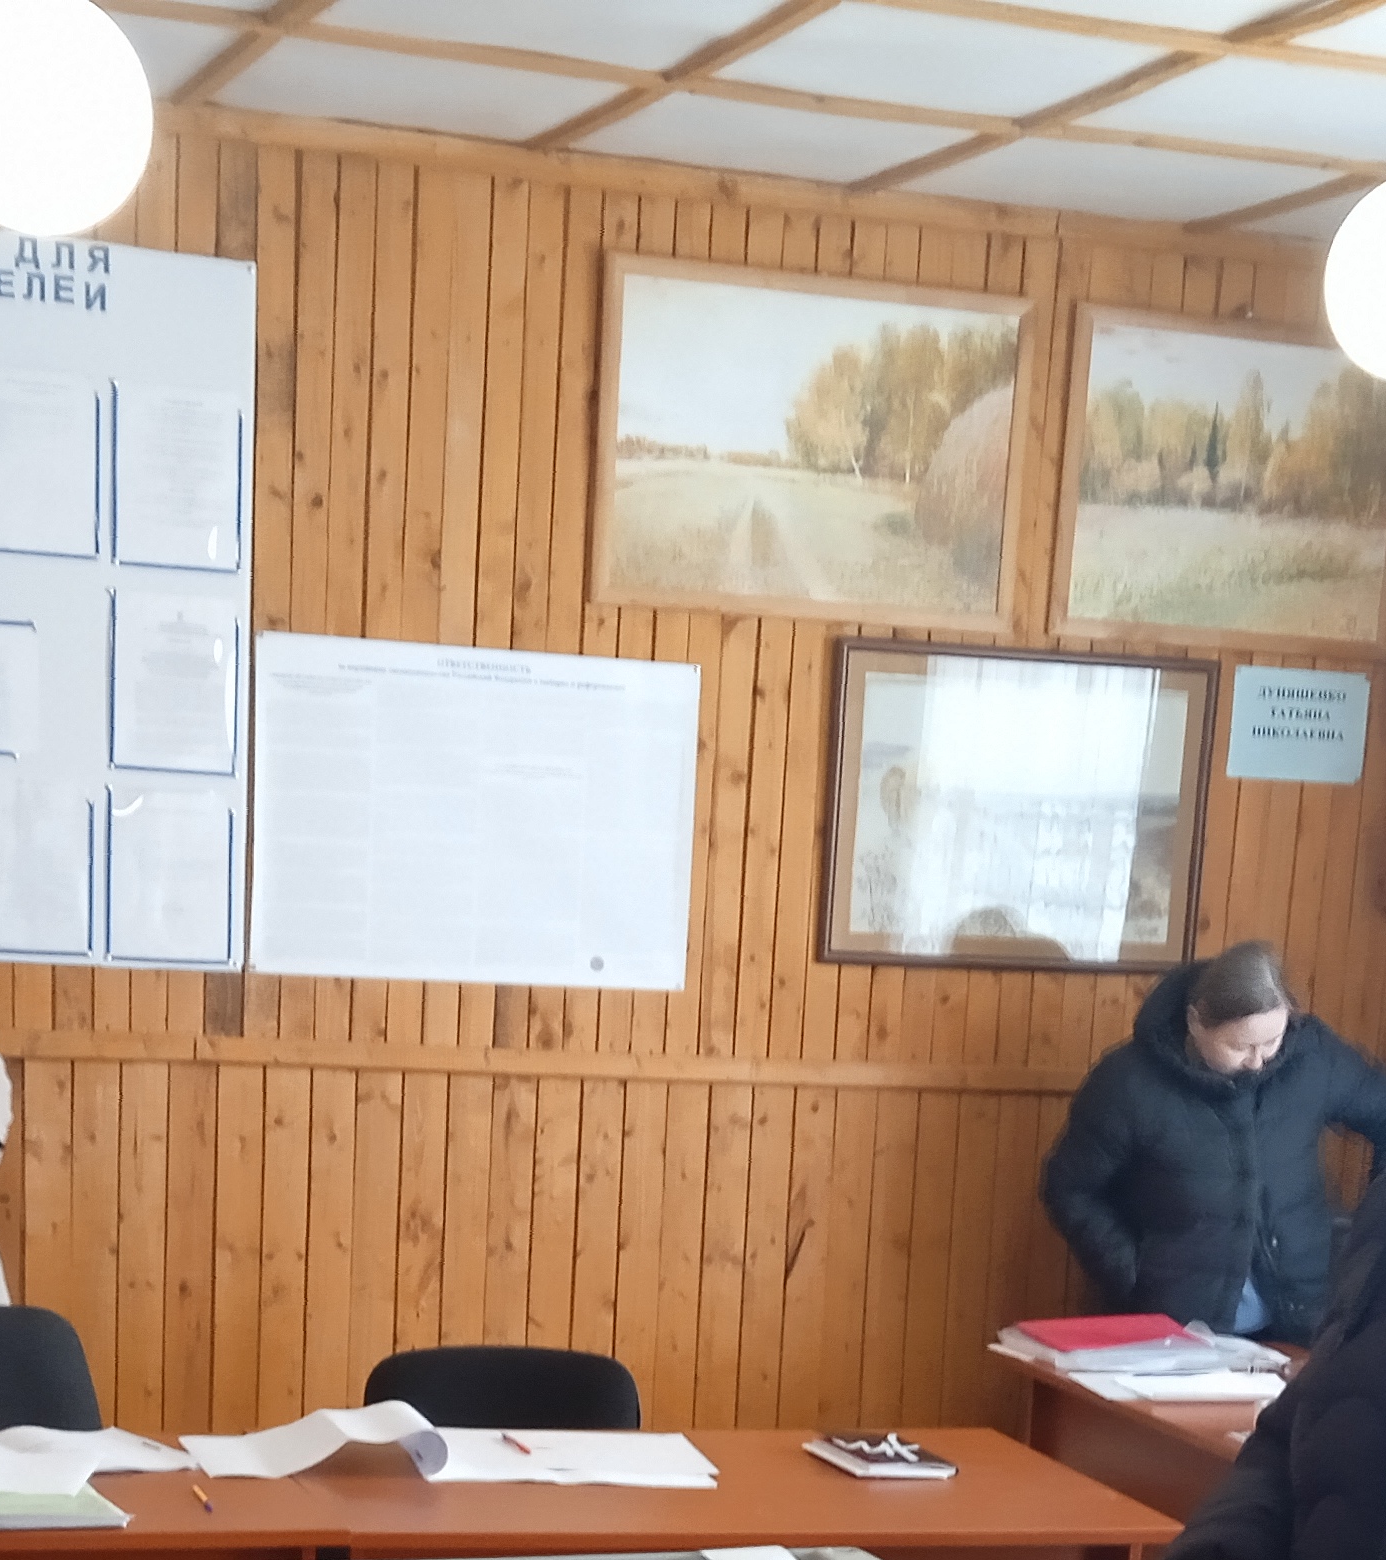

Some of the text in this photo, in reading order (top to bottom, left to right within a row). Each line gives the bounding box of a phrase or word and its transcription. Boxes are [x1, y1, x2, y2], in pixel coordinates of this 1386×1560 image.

[14, 236, 110, 274] ДЛЯ
[1270, 706, 1331, 720] ТАТЬЯНА
[1252, 726, 1344, 741] НИКОЛАЕВНА
